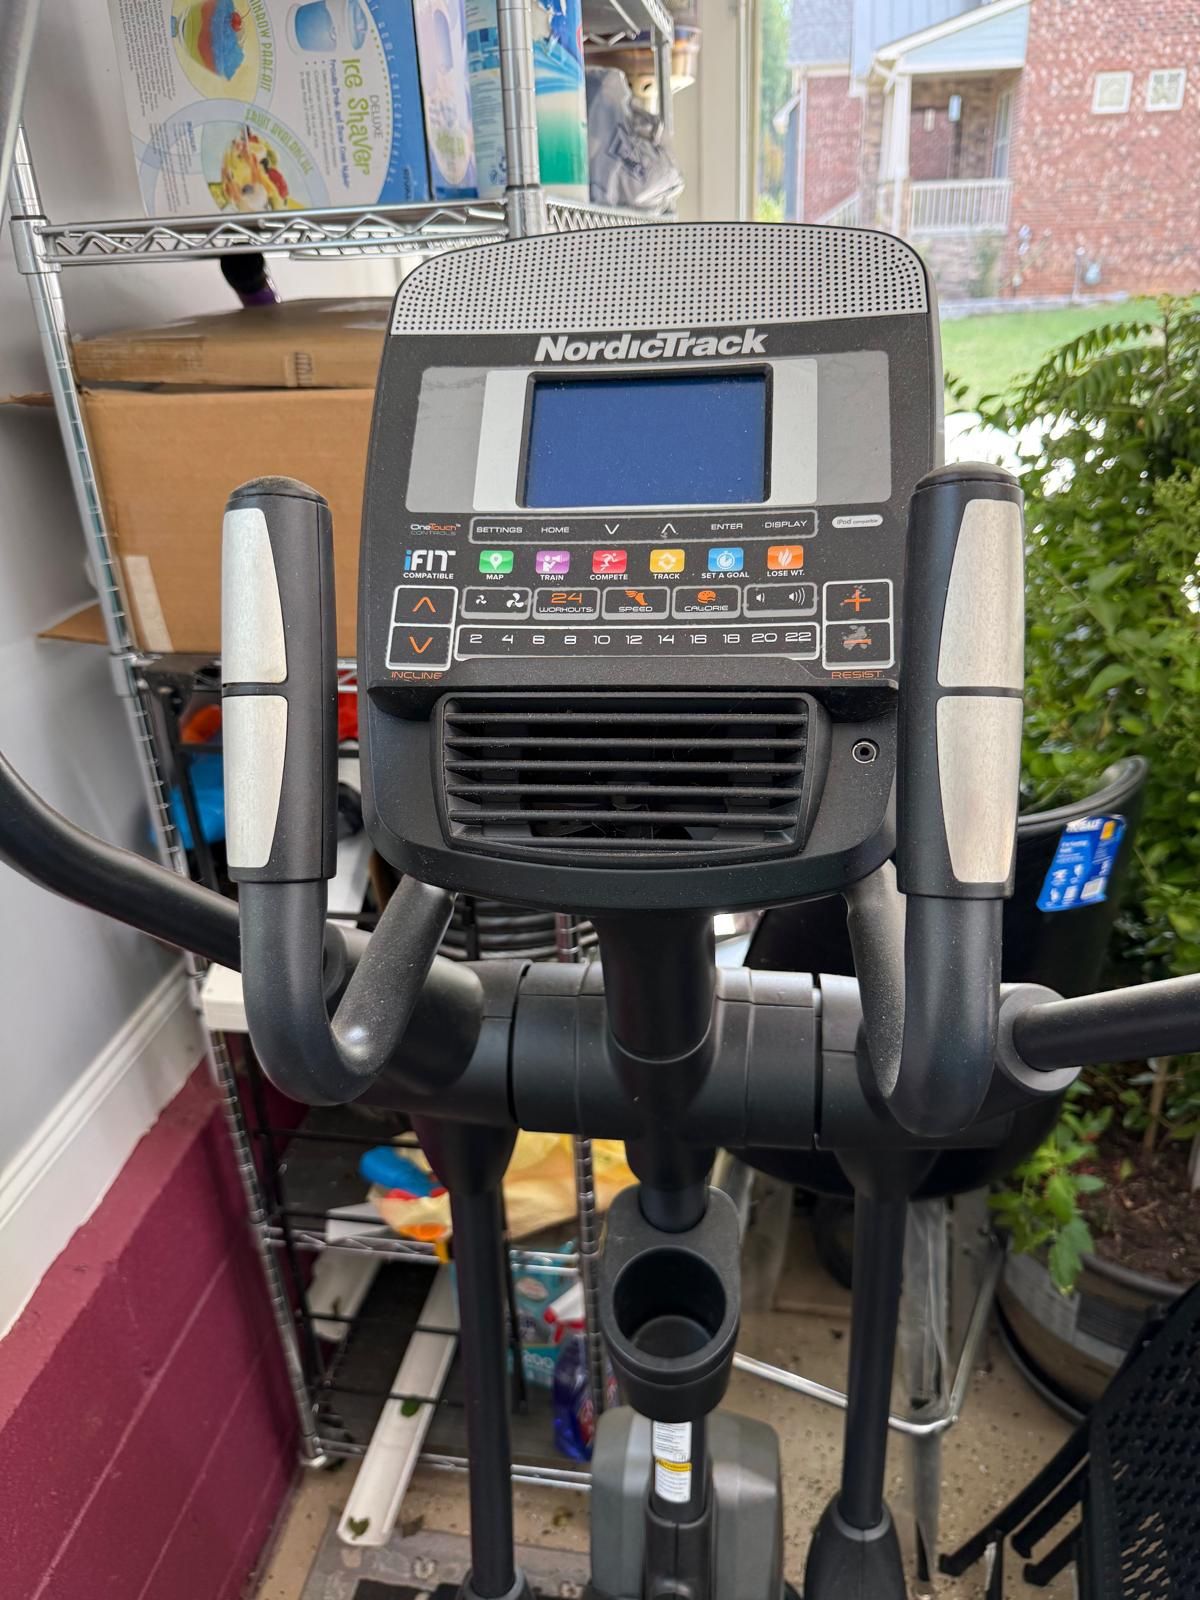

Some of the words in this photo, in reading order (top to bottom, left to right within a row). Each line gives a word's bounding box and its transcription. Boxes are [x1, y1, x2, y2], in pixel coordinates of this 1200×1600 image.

[342, 59, 363, 89] Ice
[369, 94, 384, 139] DELUXE
[345, 98, 373, 176] Shaver
[534, 328, 769, 362] NordicTrack
[476, 525, 523, 534] SETTINGS
[710, 523, 743, 531] ENTER
[764, 520, 808, 529] DISPLAY
[541, 526, 570, 534] HOME
[403, 572, 454, 580] COMPATIBLE
[551, 592, 582, 604] 24
[470, 634, 483, 644] 2
[501, 634, 514, 644] 4
[532, 635, 545, 644] 6
[564, 635, 577, 644] 8
[593, 635, 611, 645] 10
[625, 635, 643, 645] 12
[657, 634, 675, 644] 14
[690, 634, 707, 644] 16
[723, 633, 740, 643] 18
[751, 632, 777, 643] 20
[785, 631, 812, 642] 22
[391, 671, 444, 680] INCLINE
